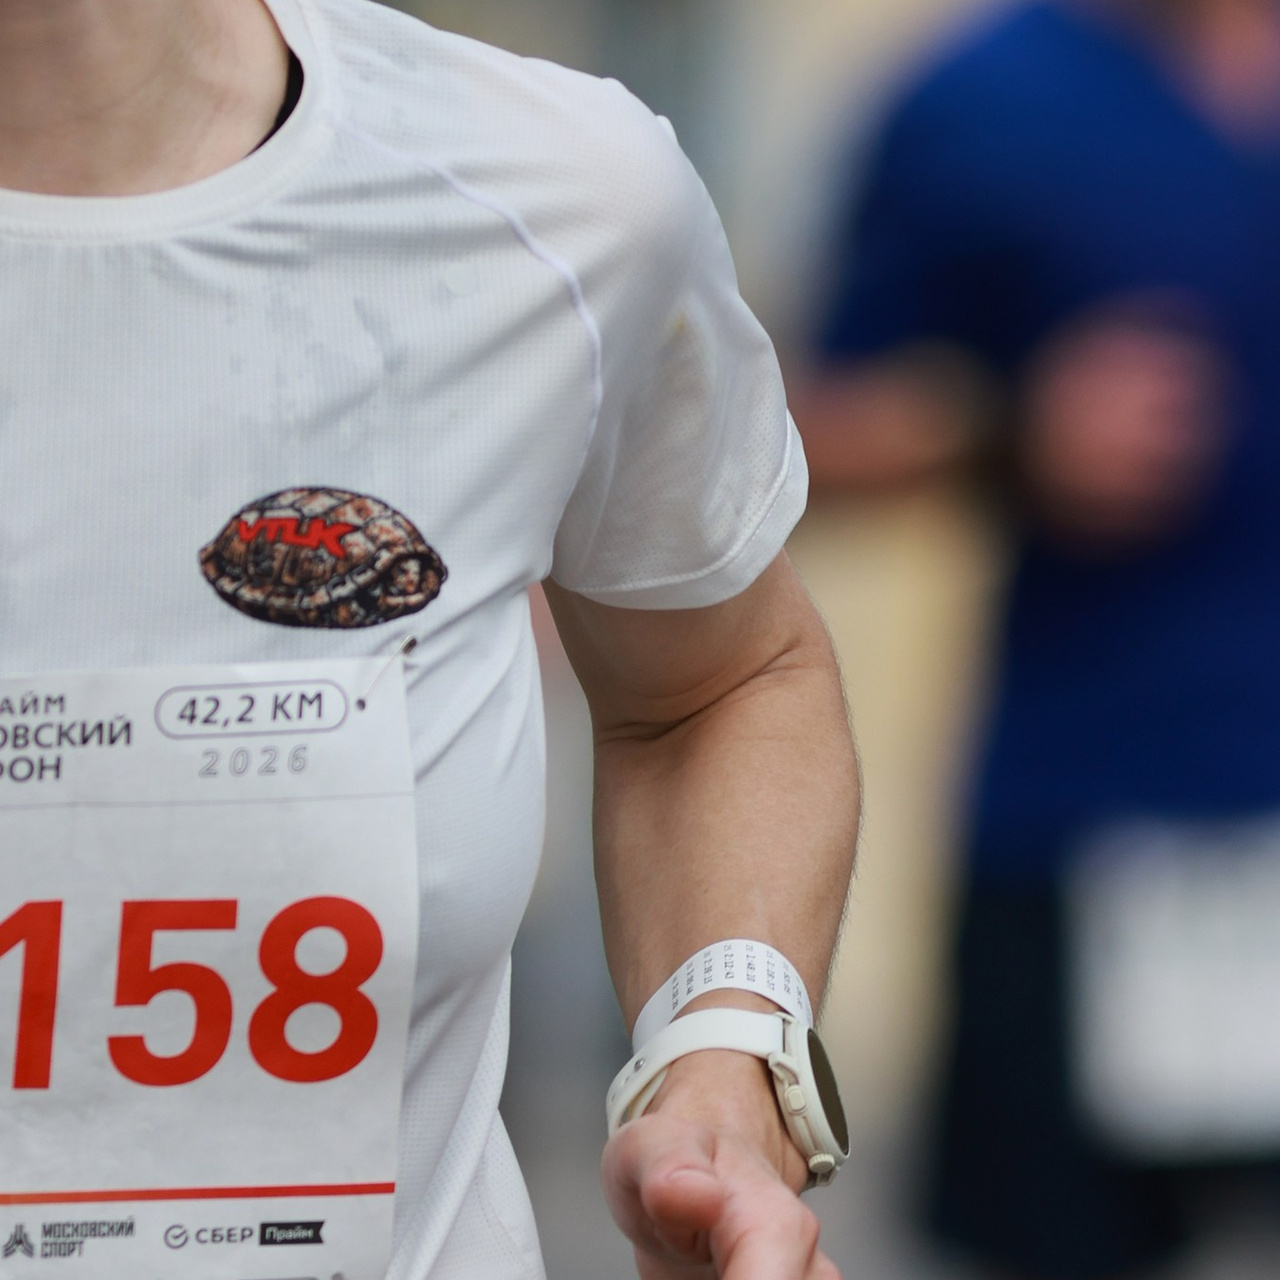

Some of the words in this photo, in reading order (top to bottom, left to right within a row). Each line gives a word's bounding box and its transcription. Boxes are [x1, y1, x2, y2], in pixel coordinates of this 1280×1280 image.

[179, 695, 255, 728] 42,2
[272, 692, 323, 721] КМ
[198, 743, 309, 778] 2026
[41, 1216, 135, 1239] МОСКОВСКИЙ
[195, 1227, 254, 1244] СБЕР
[265, 1225, 314, 1241] Прайм
[41, 1240, 84, 1259] СПОРТ
